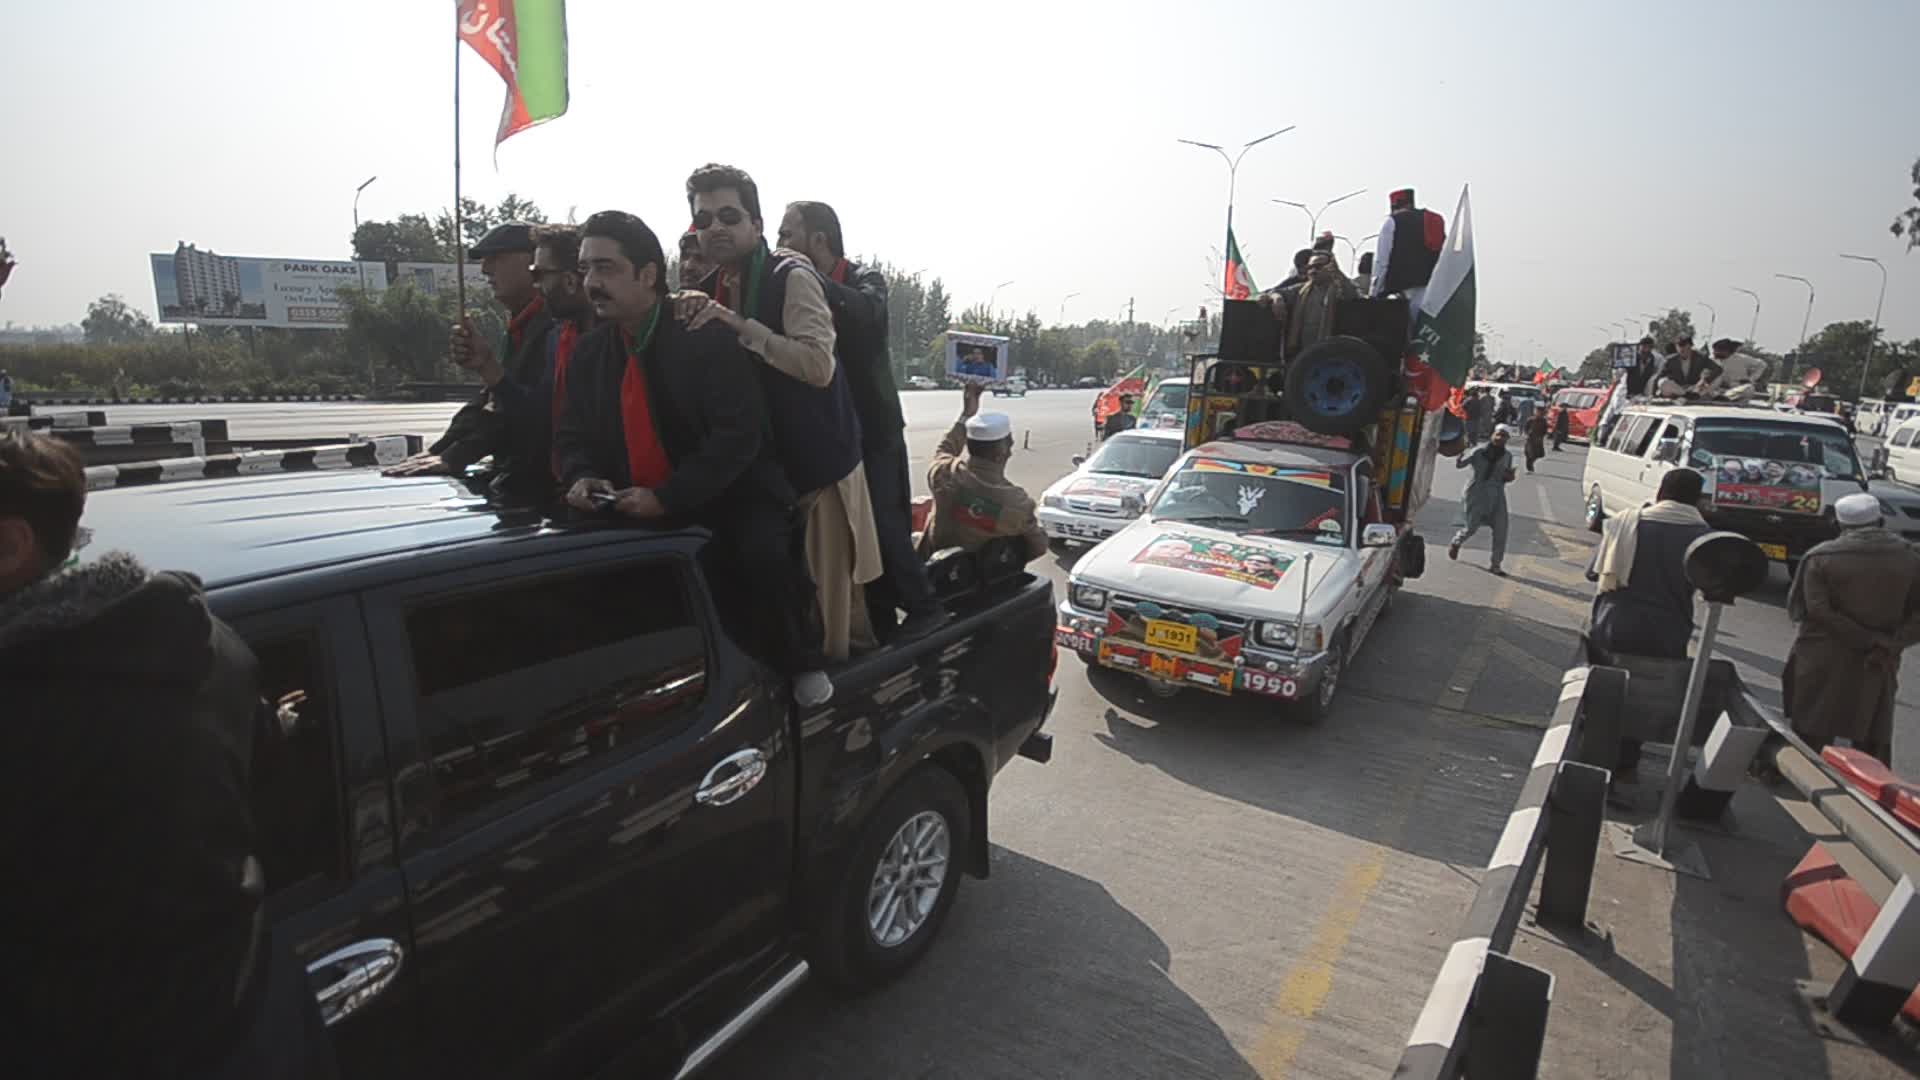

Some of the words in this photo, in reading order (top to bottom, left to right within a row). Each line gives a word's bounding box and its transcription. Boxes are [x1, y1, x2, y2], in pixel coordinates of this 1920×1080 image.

[284, 263, 319, 273] PARK
[321, 265, 357, 275] OAKS
[1792, 495, 1819, 511] 24
[1148, 627, 1156, 637] J
[1242, 671, 1297, 698] 1990
